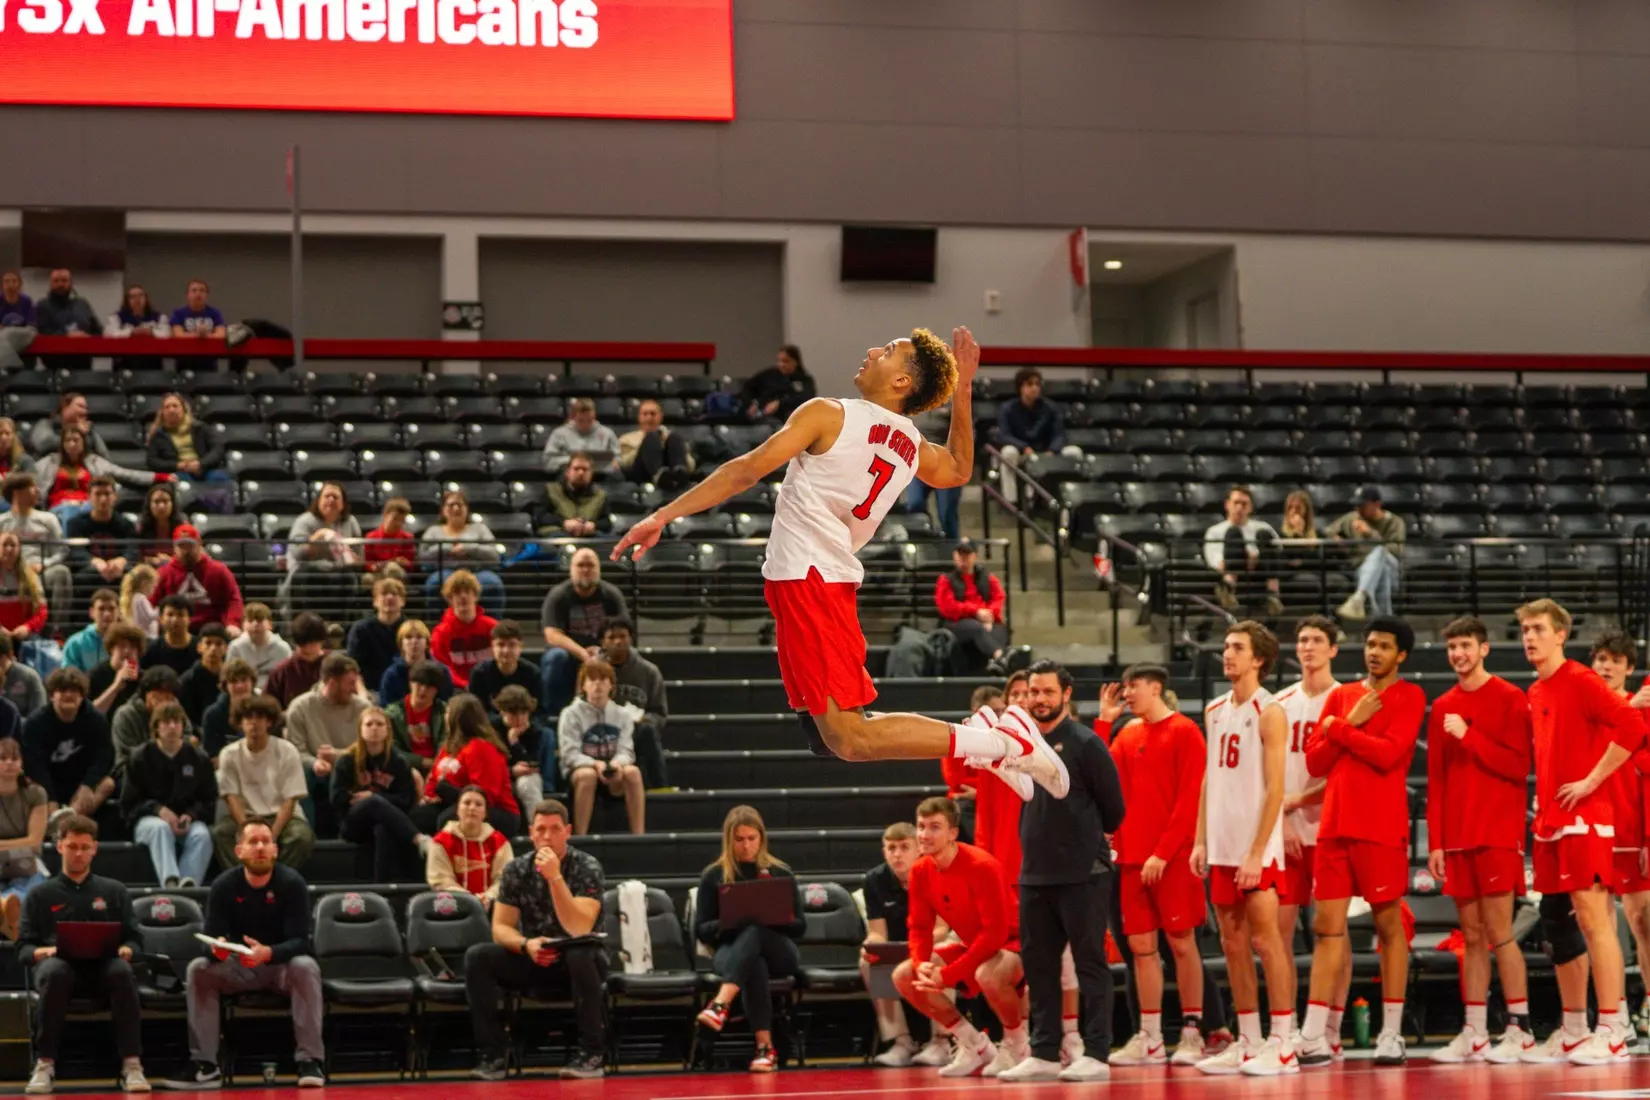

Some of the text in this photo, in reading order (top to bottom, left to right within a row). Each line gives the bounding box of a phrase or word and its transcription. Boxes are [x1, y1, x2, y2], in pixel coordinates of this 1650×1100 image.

[0, 0, 599, 48] 3x All-Americans
[851, 453, 896, 521] 7
[1218, 732, 1240, 769] 16
